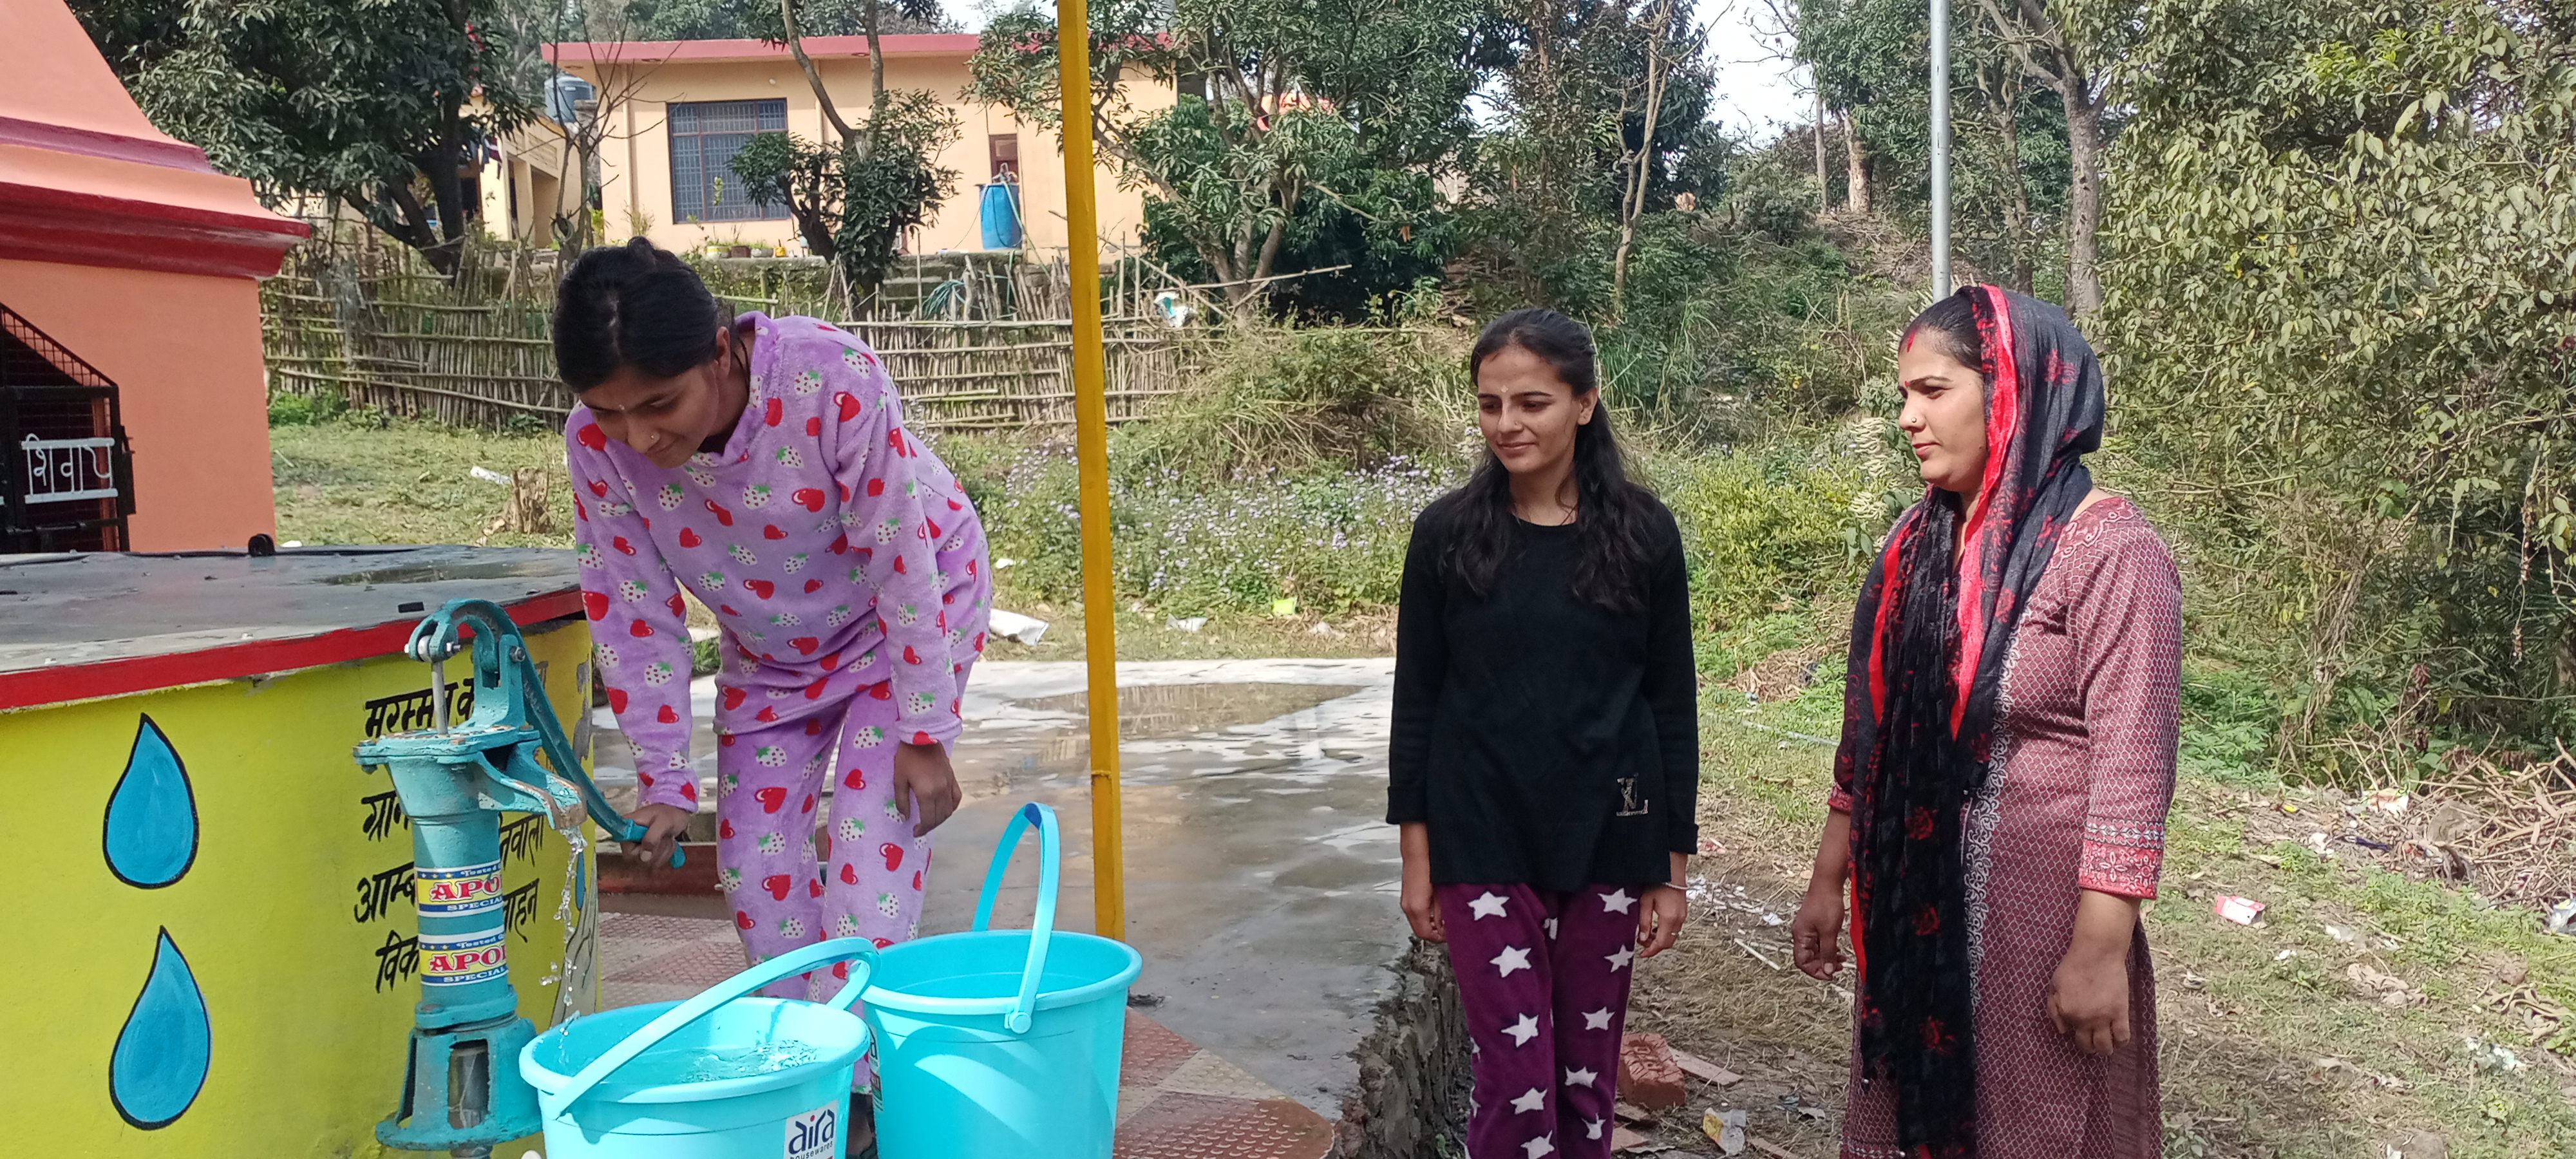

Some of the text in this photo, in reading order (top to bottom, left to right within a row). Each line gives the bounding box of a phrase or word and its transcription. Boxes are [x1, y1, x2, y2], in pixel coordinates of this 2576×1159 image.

[457, 936, 497, 948] Tested
[444, 966, 505, 983] SPECIAL
[789, 1109, 835, 1154] aira
